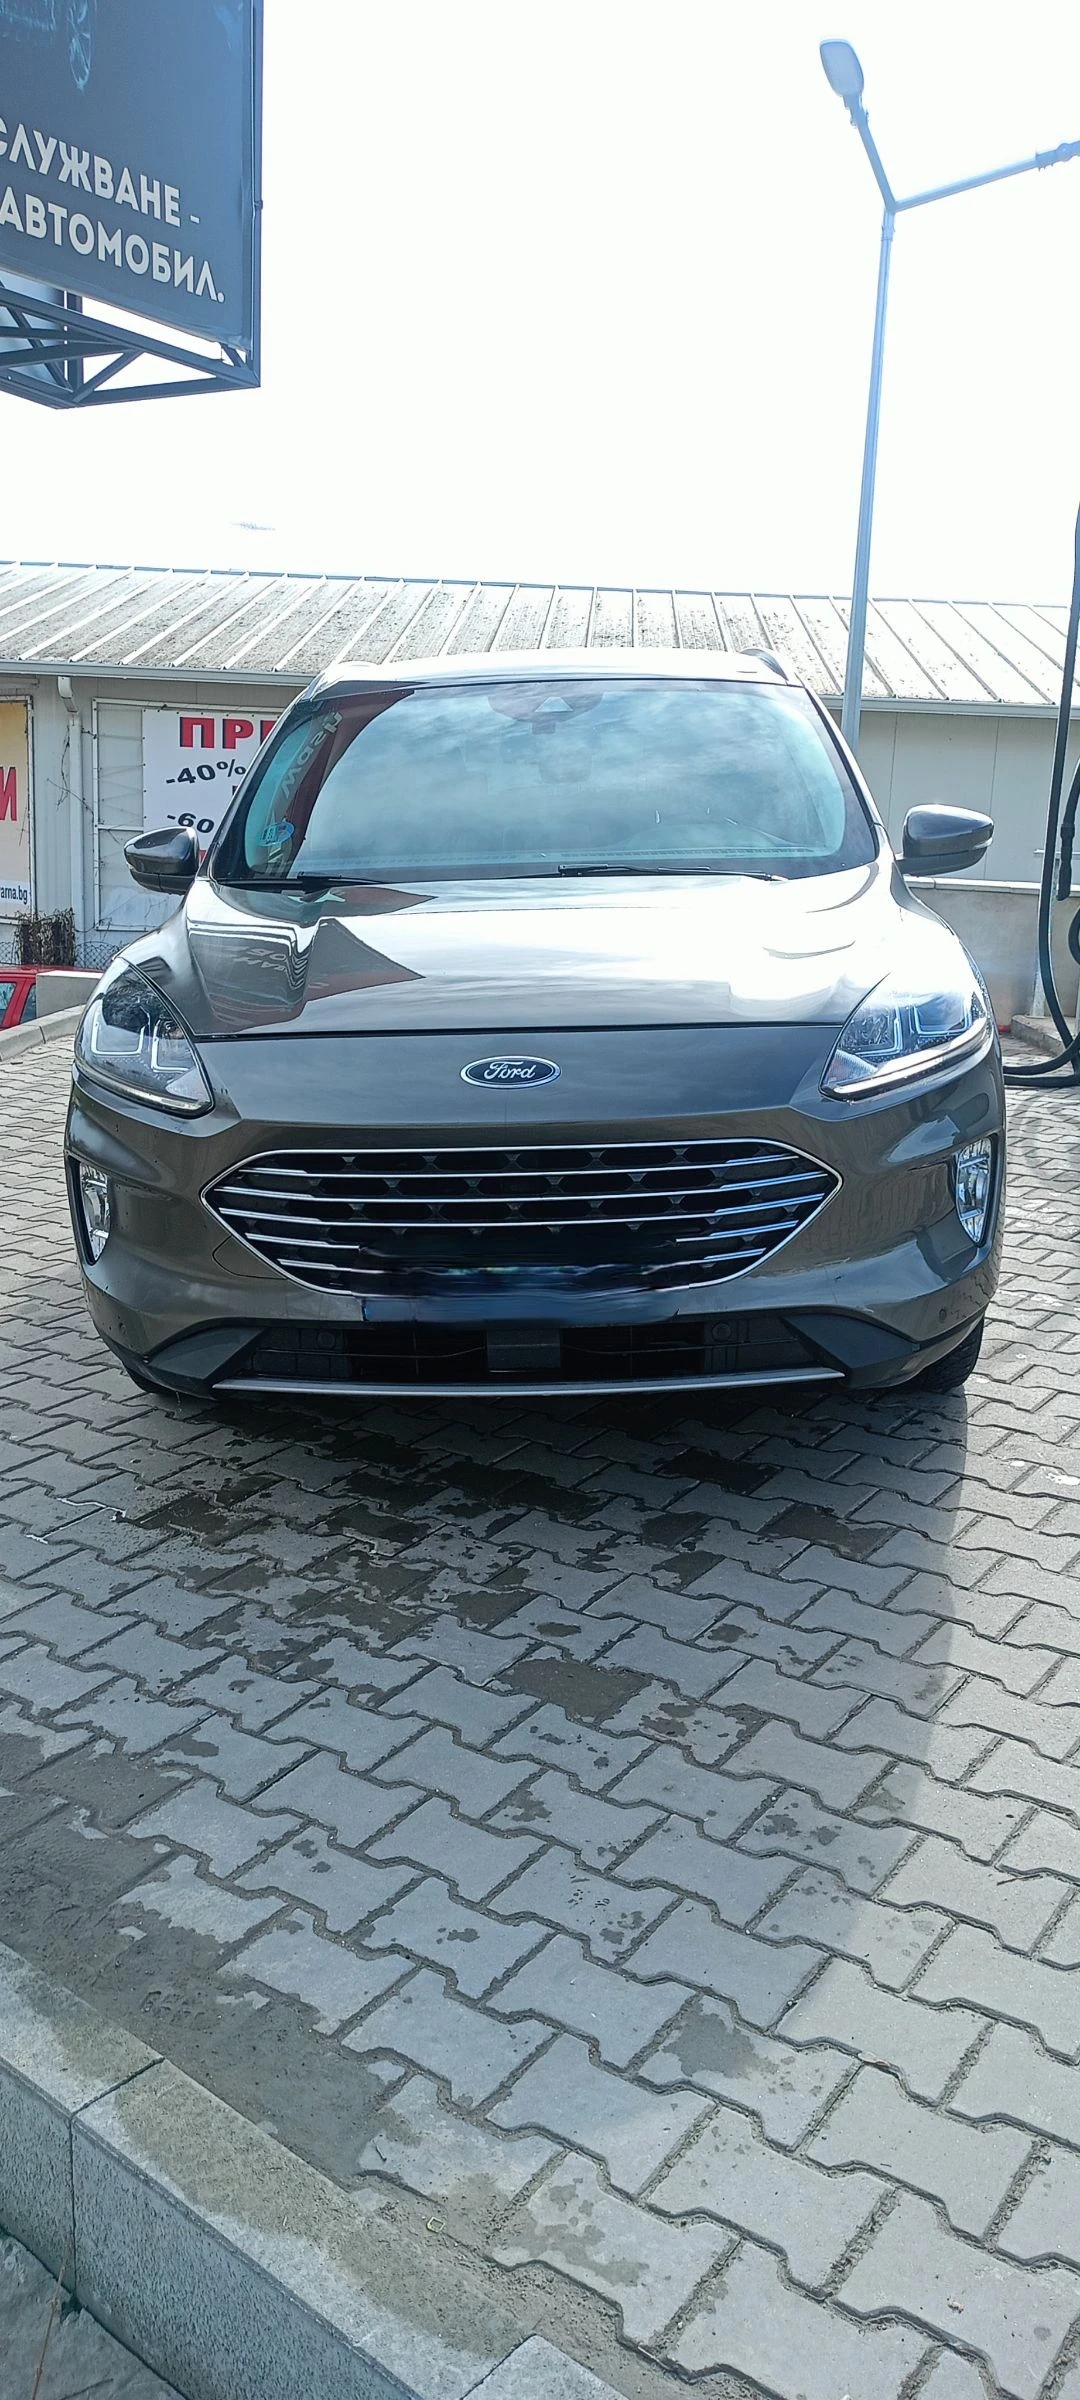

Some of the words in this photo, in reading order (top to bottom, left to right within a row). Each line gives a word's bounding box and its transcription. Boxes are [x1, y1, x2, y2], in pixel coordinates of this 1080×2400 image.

[0, 186, 225, 303] АВТОМОБИЛ.
[166, 759, 247, 784] -40%
[0, 885, 28, 905] arna.bg
[484, 1061, 537, 1080] Ford
